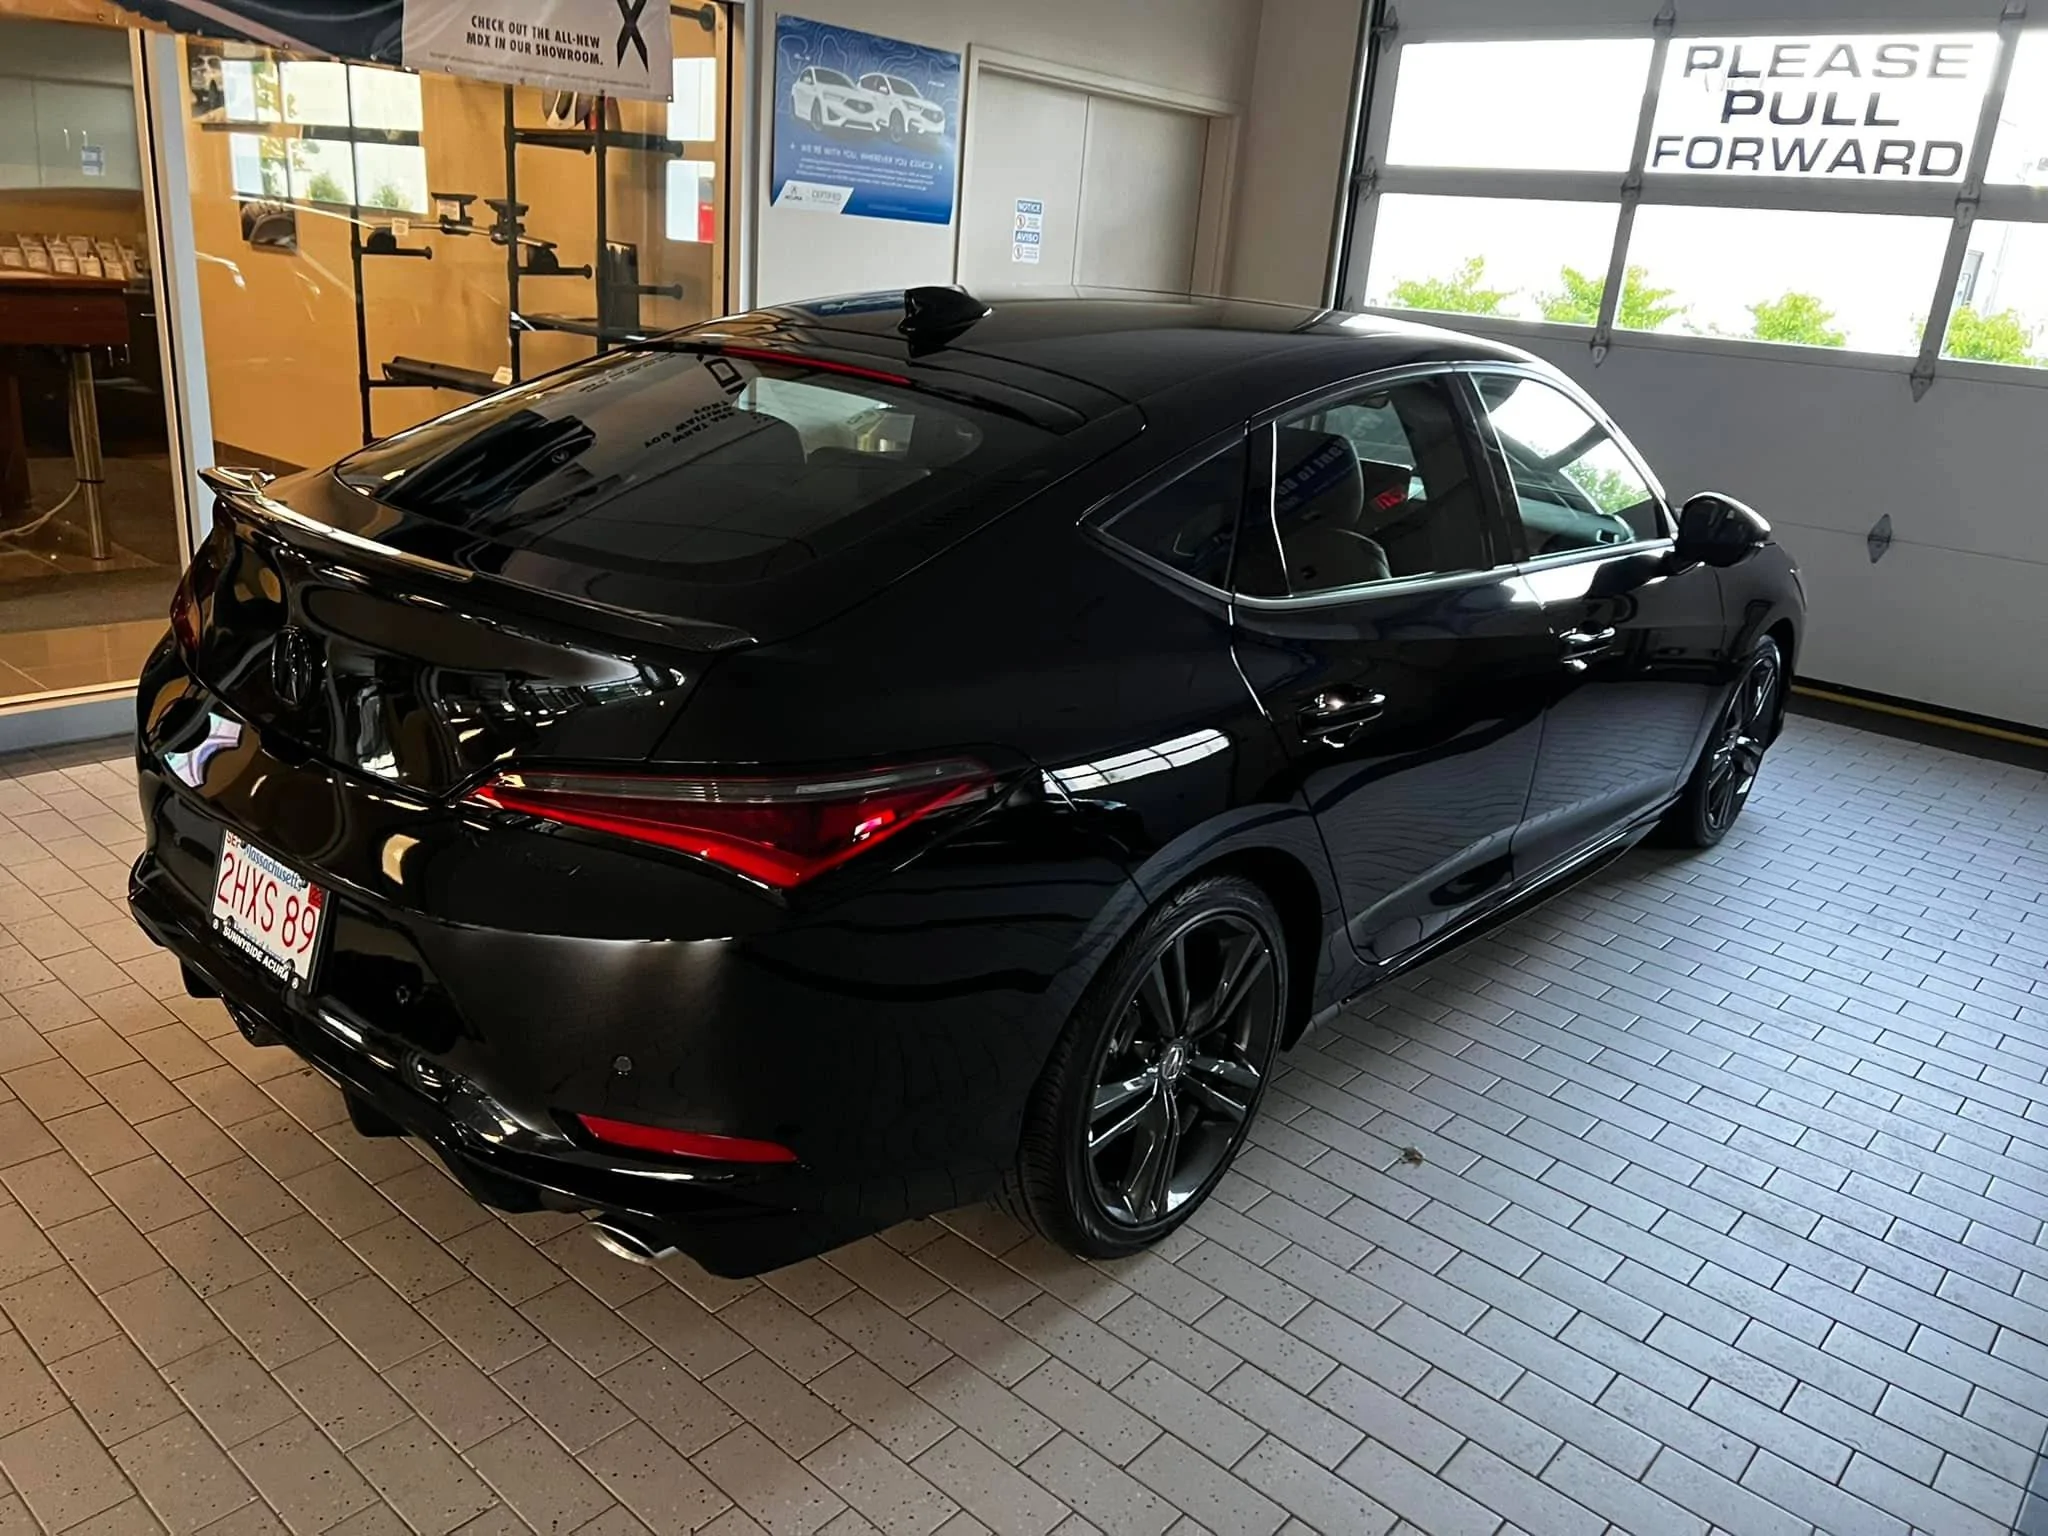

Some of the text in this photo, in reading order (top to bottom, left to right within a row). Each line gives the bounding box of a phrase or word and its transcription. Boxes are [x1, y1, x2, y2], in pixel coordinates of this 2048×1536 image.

[466, 32, 604, 65] MDX IN OUR SHOWROOM.
[471, 15, 600, 49] CHECK OUT THE ALL-NEW
[1683, 43, 1974, 79] PLEASE
[1721, 89, 1900, 126] PULL
[1652, 135, 1964, 177] FORWARD
[1018, 202, 1041, 213] NOTICE
[1016, 232, 1039, 243] AVISO
[217, 852, 278, 932] 2HXS
[281, 895, 316, 954] 89
[222, 925, 265, 963] SUNNYSIDE
[263, 953, 291, 982] ACURA
